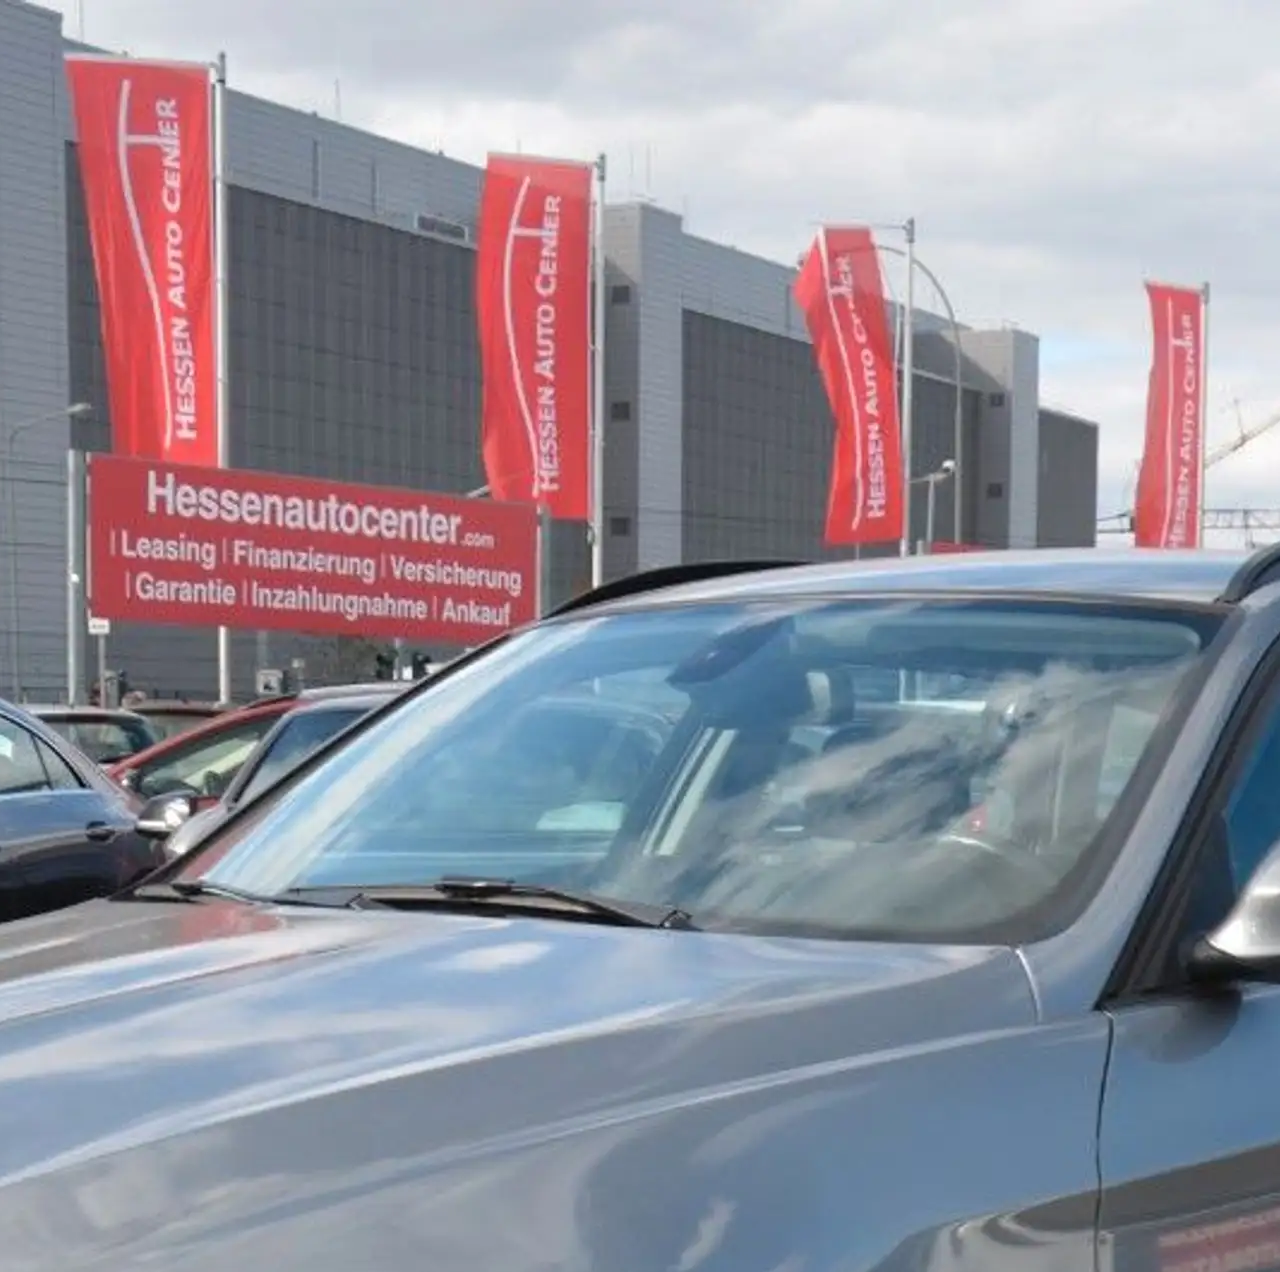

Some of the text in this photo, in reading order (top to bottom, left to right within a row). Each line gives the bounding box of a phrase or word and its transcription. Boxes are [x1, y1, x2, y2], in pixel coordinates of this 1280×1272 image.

[162, 224, 188, 309] AUTO
[167, 316, 197, 440] HESSEN
[534, 303, 561, 380] AUTO
[835, 254, 886, 518] HESSEN AUTO CTER
[535, 385, 561, 492] HESSEN
[1180, 400, 1195, 461] AUTO
[147, 470, 495, 548] Hessenautocenter.com
[121, 529, 522, 597] Leasing Finanzierung Versicherung
[135, 571, 511, 626] Garantie Inzahlungnahme Ankauf
